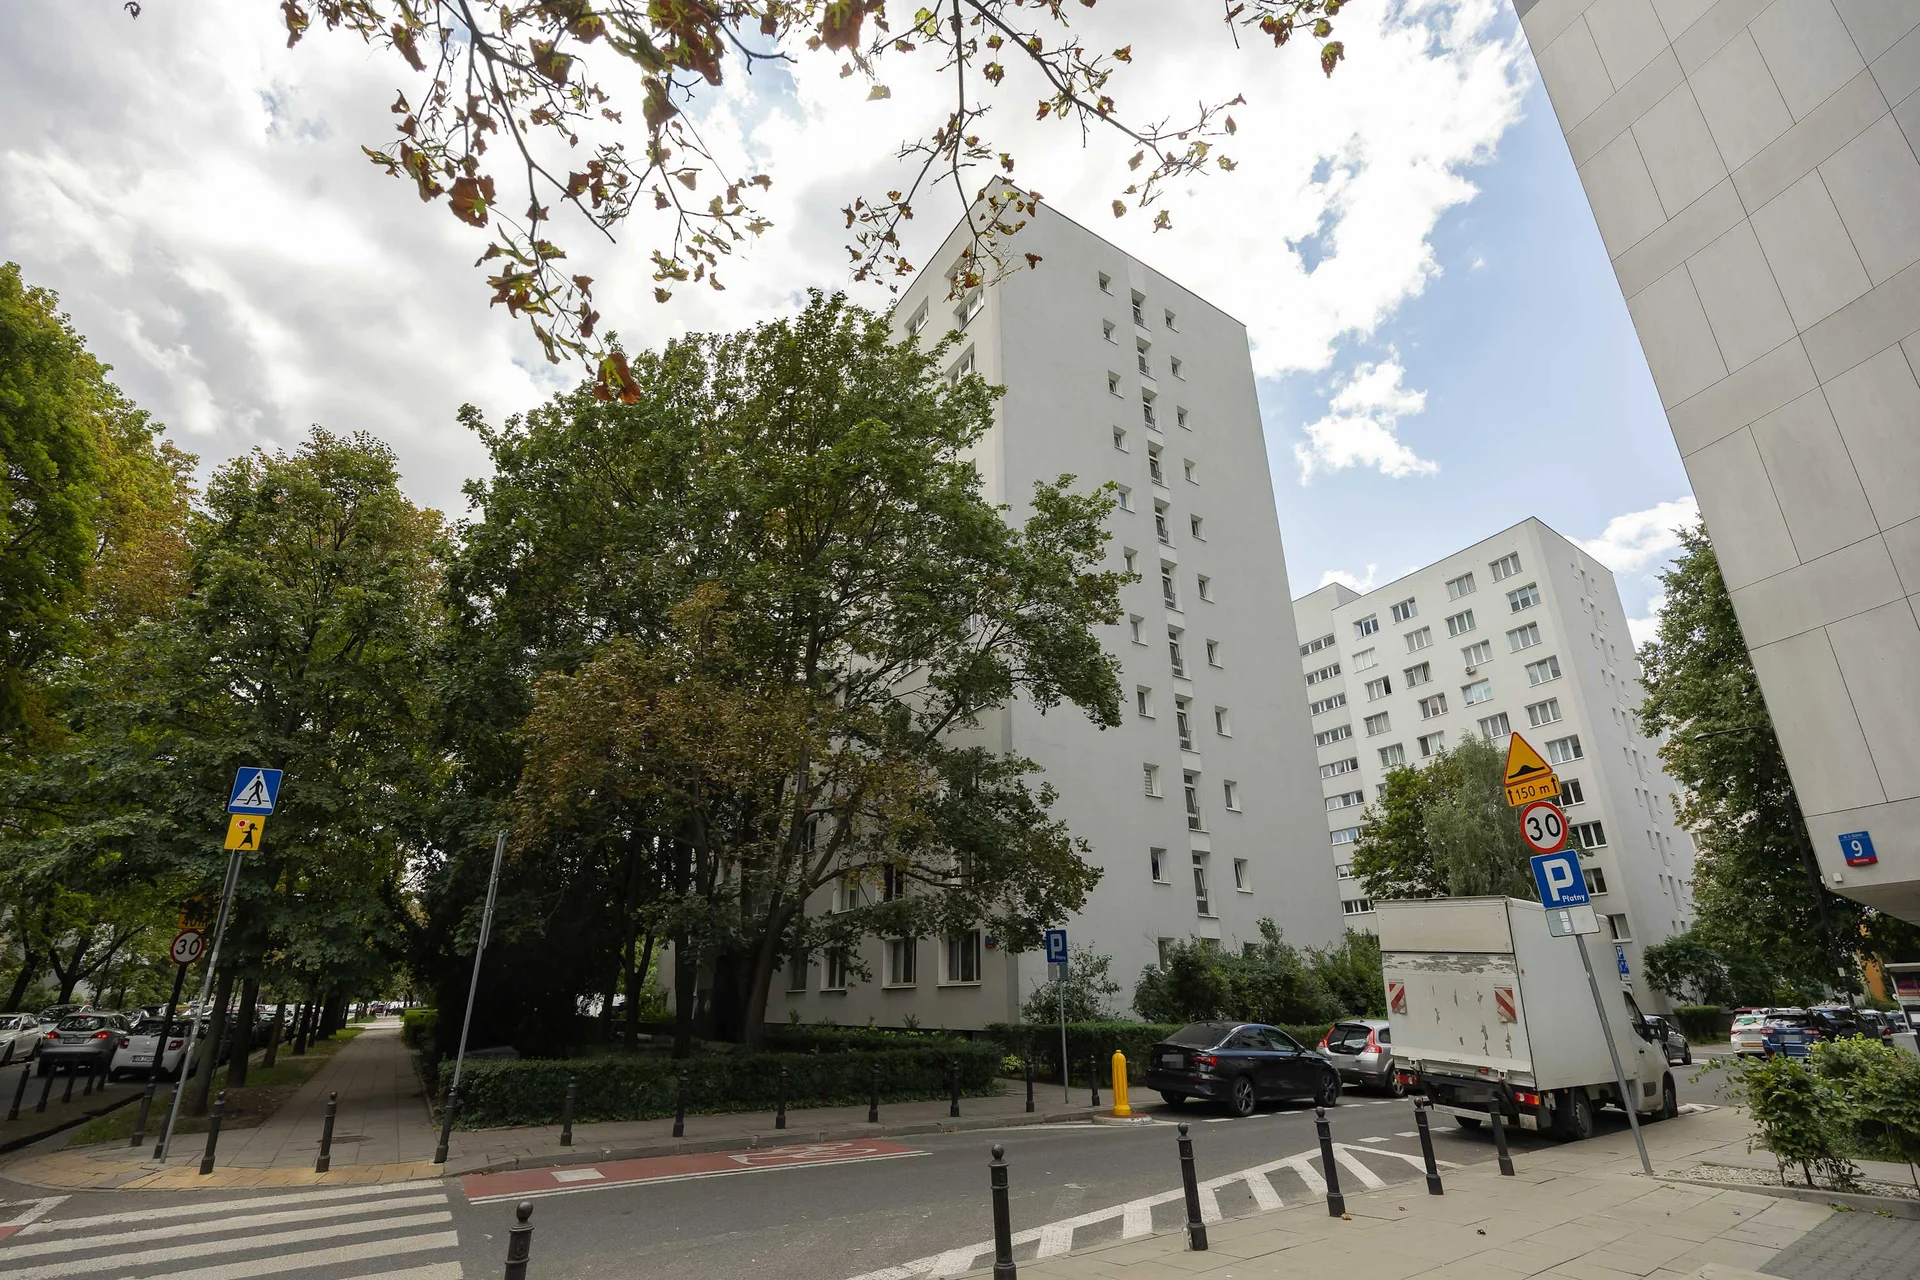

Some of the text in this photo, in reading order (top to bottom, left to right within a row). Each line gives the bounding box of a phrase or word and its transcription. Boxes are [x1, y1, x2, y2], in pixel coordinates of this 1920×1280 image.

[1515, 785, 1550, 801] 150 m
[1527, 813, 1561, 841] 30
[1851, 840, 1863, 857] 9
[1542, 858, 1574, 902] P
[1562, 894, 1585, 903] Płatny
[176, 939, 200, 955] 30
[1051, 934, 1063, 959] P
[1616, 946, 1623, 958] P
